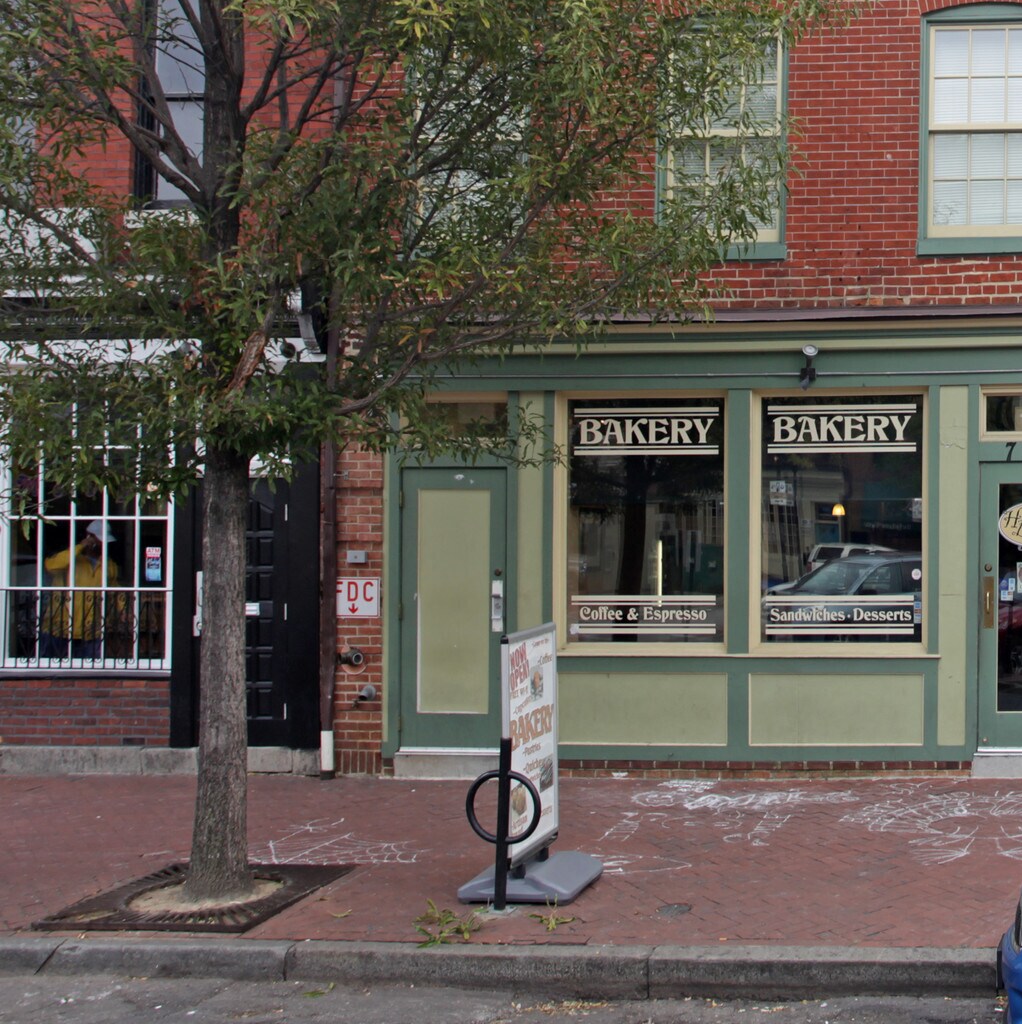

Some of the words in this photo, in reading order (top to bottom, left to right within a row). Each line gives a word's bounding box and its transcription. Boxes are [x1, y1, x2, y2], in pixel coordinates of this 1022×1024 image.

[579, 418, 714, 444] BAKERY
[773, 415, 912, 442] BAKERY
[580, 606, 623, 621] Coffee
[626, 607, 639, 621] &
[643, 606, 707, 623] Espresso
[770, 607, 845, 622] Sandwiches
[853, 607, 912, 622] Desserts
[510, 642, 527, 671] NOW
[510, 703, 554, 753] BAKERY
